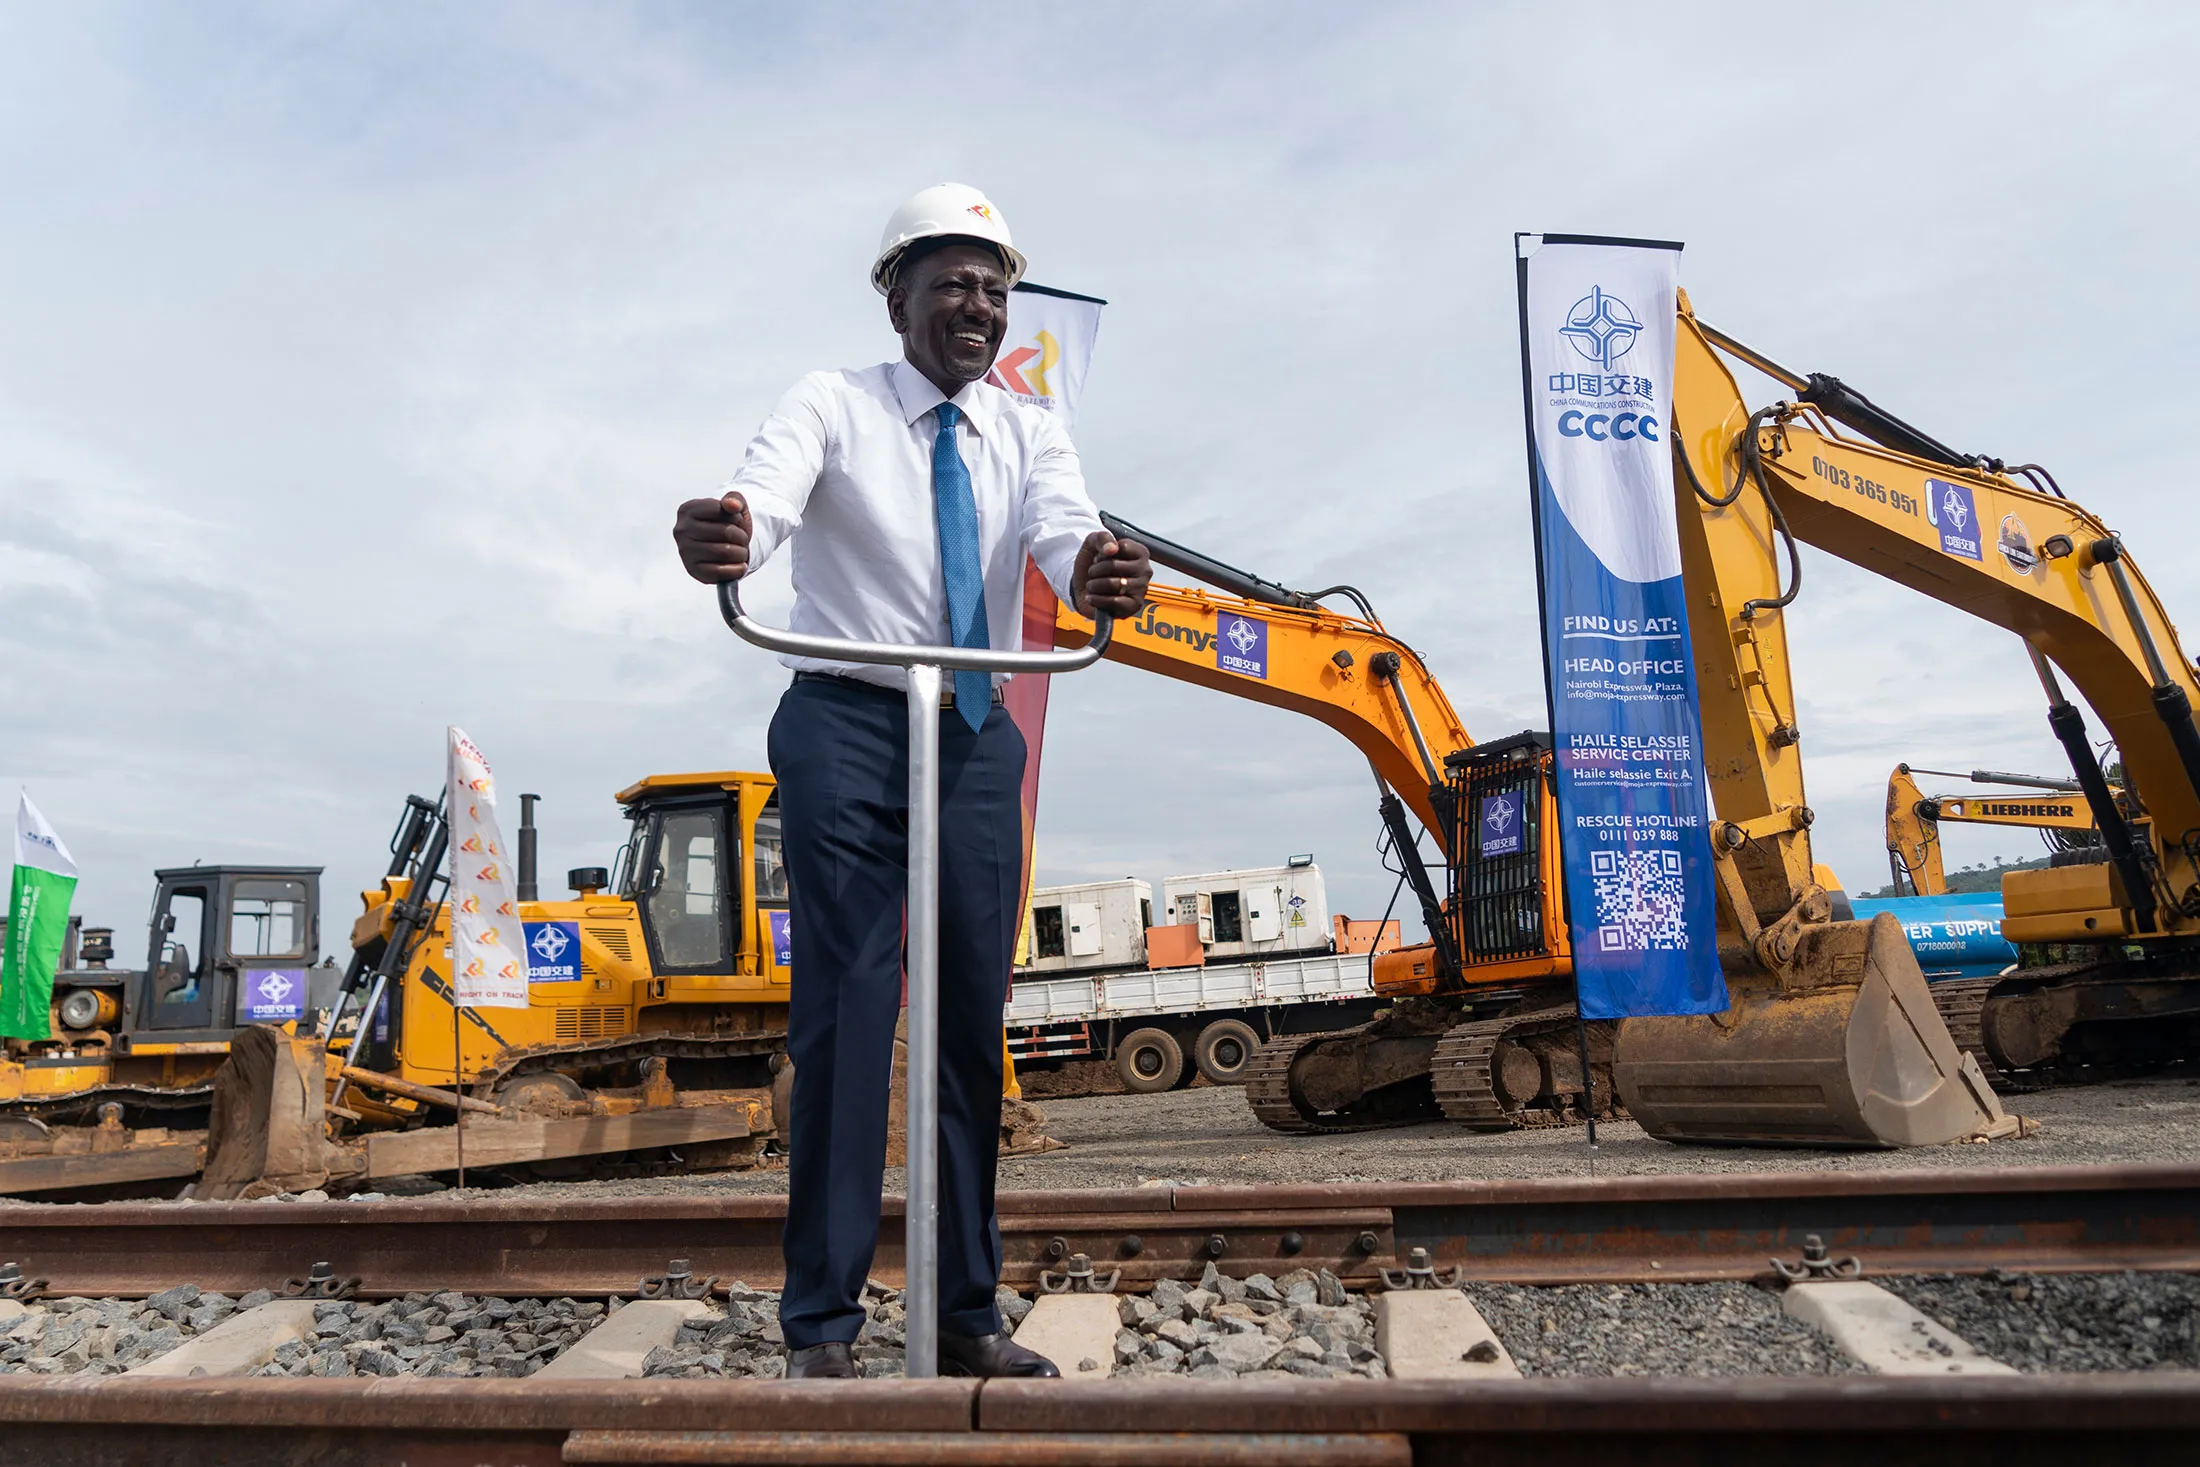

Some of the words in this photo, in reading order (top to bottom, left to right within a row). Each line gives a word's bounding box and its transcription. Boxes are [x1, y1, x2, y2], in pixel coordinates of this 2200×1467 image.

[1549, 372, 1653, 401] 中国交建
[1550, 398, 1568, 406] CHINA
[1569, 398, 1617, 409] COMMUNICATIONS
[1558, 410, 1659, 442] CCCC
[1812, 455, 1850, 490] 0703
[1854, 475, 1887, 504] 365
[1890, 489, 1918, 517] 951
[1944, 535, 1977, 553] 中国交建
[1135, 603, 1217, 651] Jonya
[1564, 616, 1610, 631] FIND
[1613, 619, 1639, 633] US
[1644, 617, 1677, 632] AT:
[1223, 655, 1261, 672] 中国交建
[1565, 658, 1615, 674] HEAD
[1618, 659, 1684, 676] OFFICE
[1566, 680, 1602, 689] Nairobi
[1604, 680, 1652, 692] Expressway
[1655, 683, 1684, 691] Plaza,
[1570, 734, 1617, 747] HAILE
[1620, 735, 1690, 748] SELASSIE
[1572, 748, 1629, 760] SERVICE
[1632, 749, 1691, 761] CENTER
[1573, 768, 1606, 779] Haile
[1609, 768, 1651, 780] selassie
[1655, 768, 1679, 780] Exit
[1681, 769, 1693, 780] A,
[1982, 804, 2074, 817] LIEBHERR
[1577, 816, 1632, 827] RESCUE
[1636, 816, 1697, 827] HOTLINE
[1600, 830, 1627, 841] 0111
[1633, 830, 1656, 841] 039
[1660, 830, 1679, 841] 888
[1483, 836, 1518, 851] 中国交建
[1902, 925, 1933, 940] TER
[1945, 921, 2001, 937] SUPPL
[502, 991, 524, 999] TRACK
